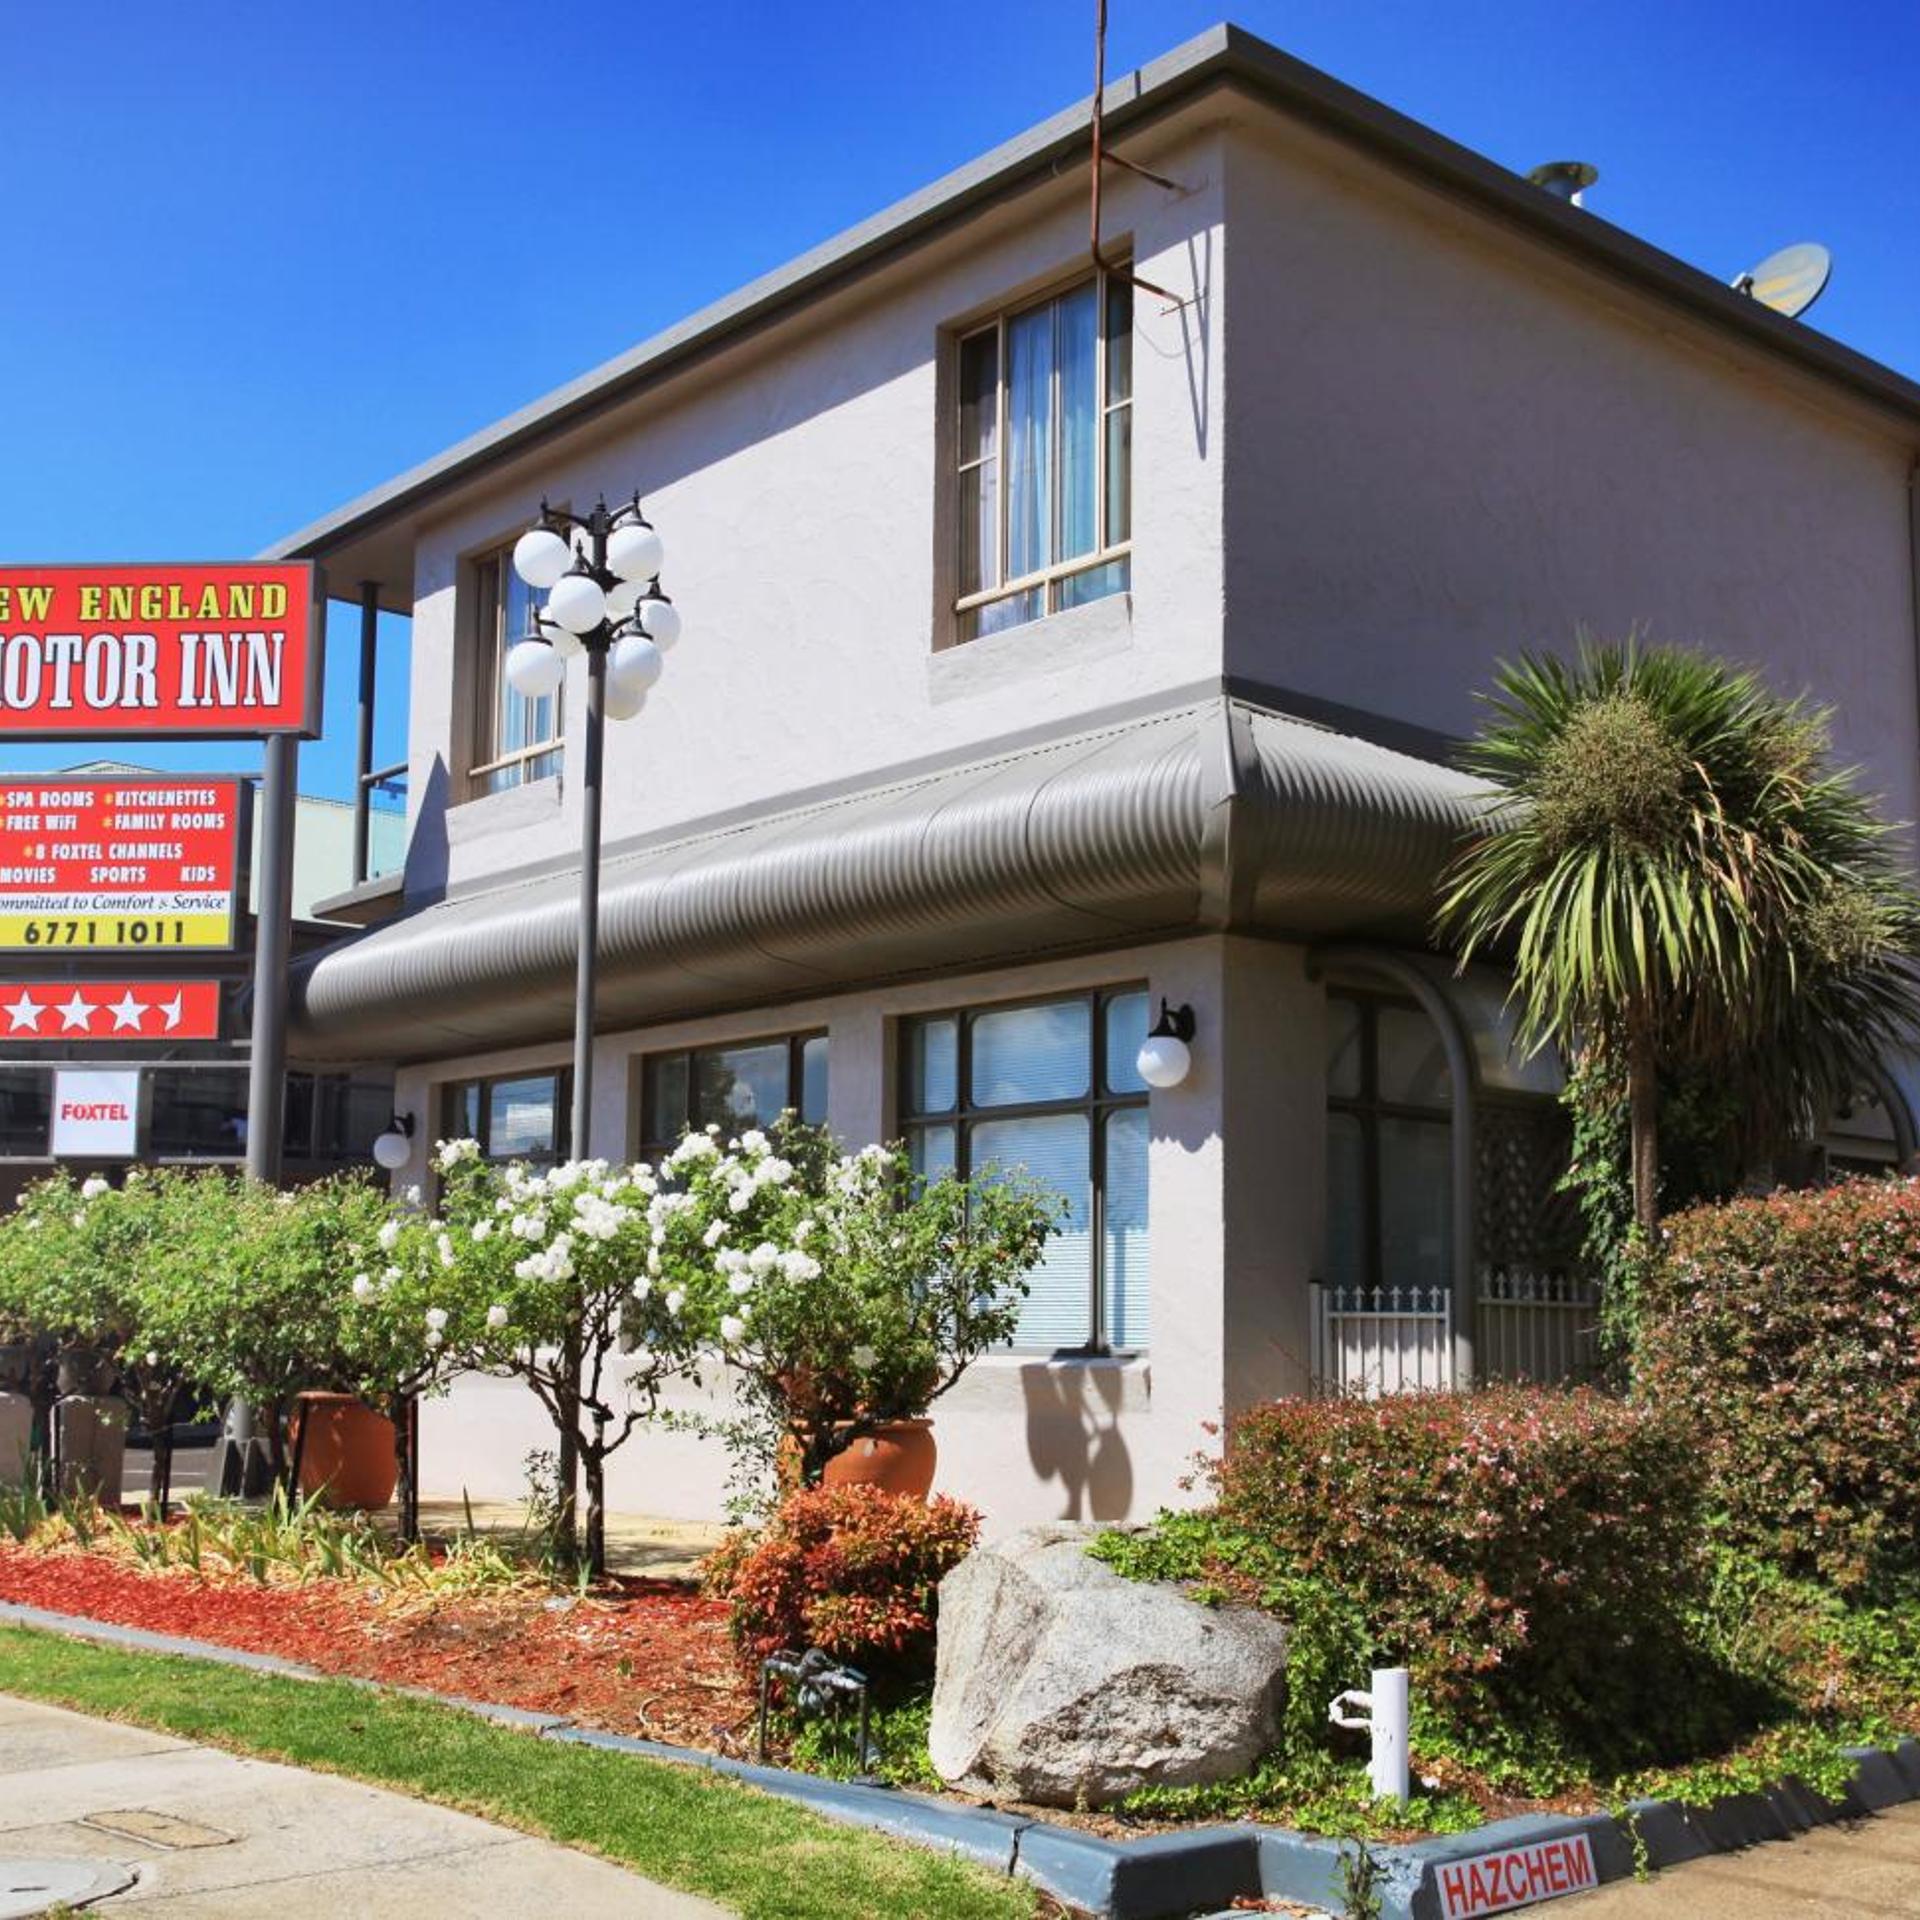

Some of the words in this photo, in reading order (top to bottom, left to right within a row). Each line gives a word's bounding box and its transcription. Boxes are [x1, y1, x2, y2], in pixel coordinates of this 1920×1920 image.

[79, 583, 288, 621] ENGLAND
[0, 634, 158, 709] OTOR
[177, 632, 285, 706] INN
[7, 791, 34, 808] SPA
[40, 791, 95, 807] ROOMS
[115, 790, 216, 806] KITCHENETTES
[6, 815, 40, 831] FREE
[114, 814, 166, 829] FAMILY
[171, 813, 225, 829] ROOMS
[51, 843, 102, 860] FOXTEL
[109, 842, 183, 859] CHANNELS
[0, 867, 56, 883] MOVIES
[90, 866, 147, 883] SPORTS
[180, 866, 216, 882] KIDS
[73, 896, 88, 909] to
[92, 894, 154, 910] Comfort
[172, 894, 225, 909] Service
[24, 921, 96, 944] 6771
[117, 921, 183, 943] 1011
[61, 1103, 129, 1121] FOXTEL
[1443, 1839, 1591, 1916] HAZCHEM
